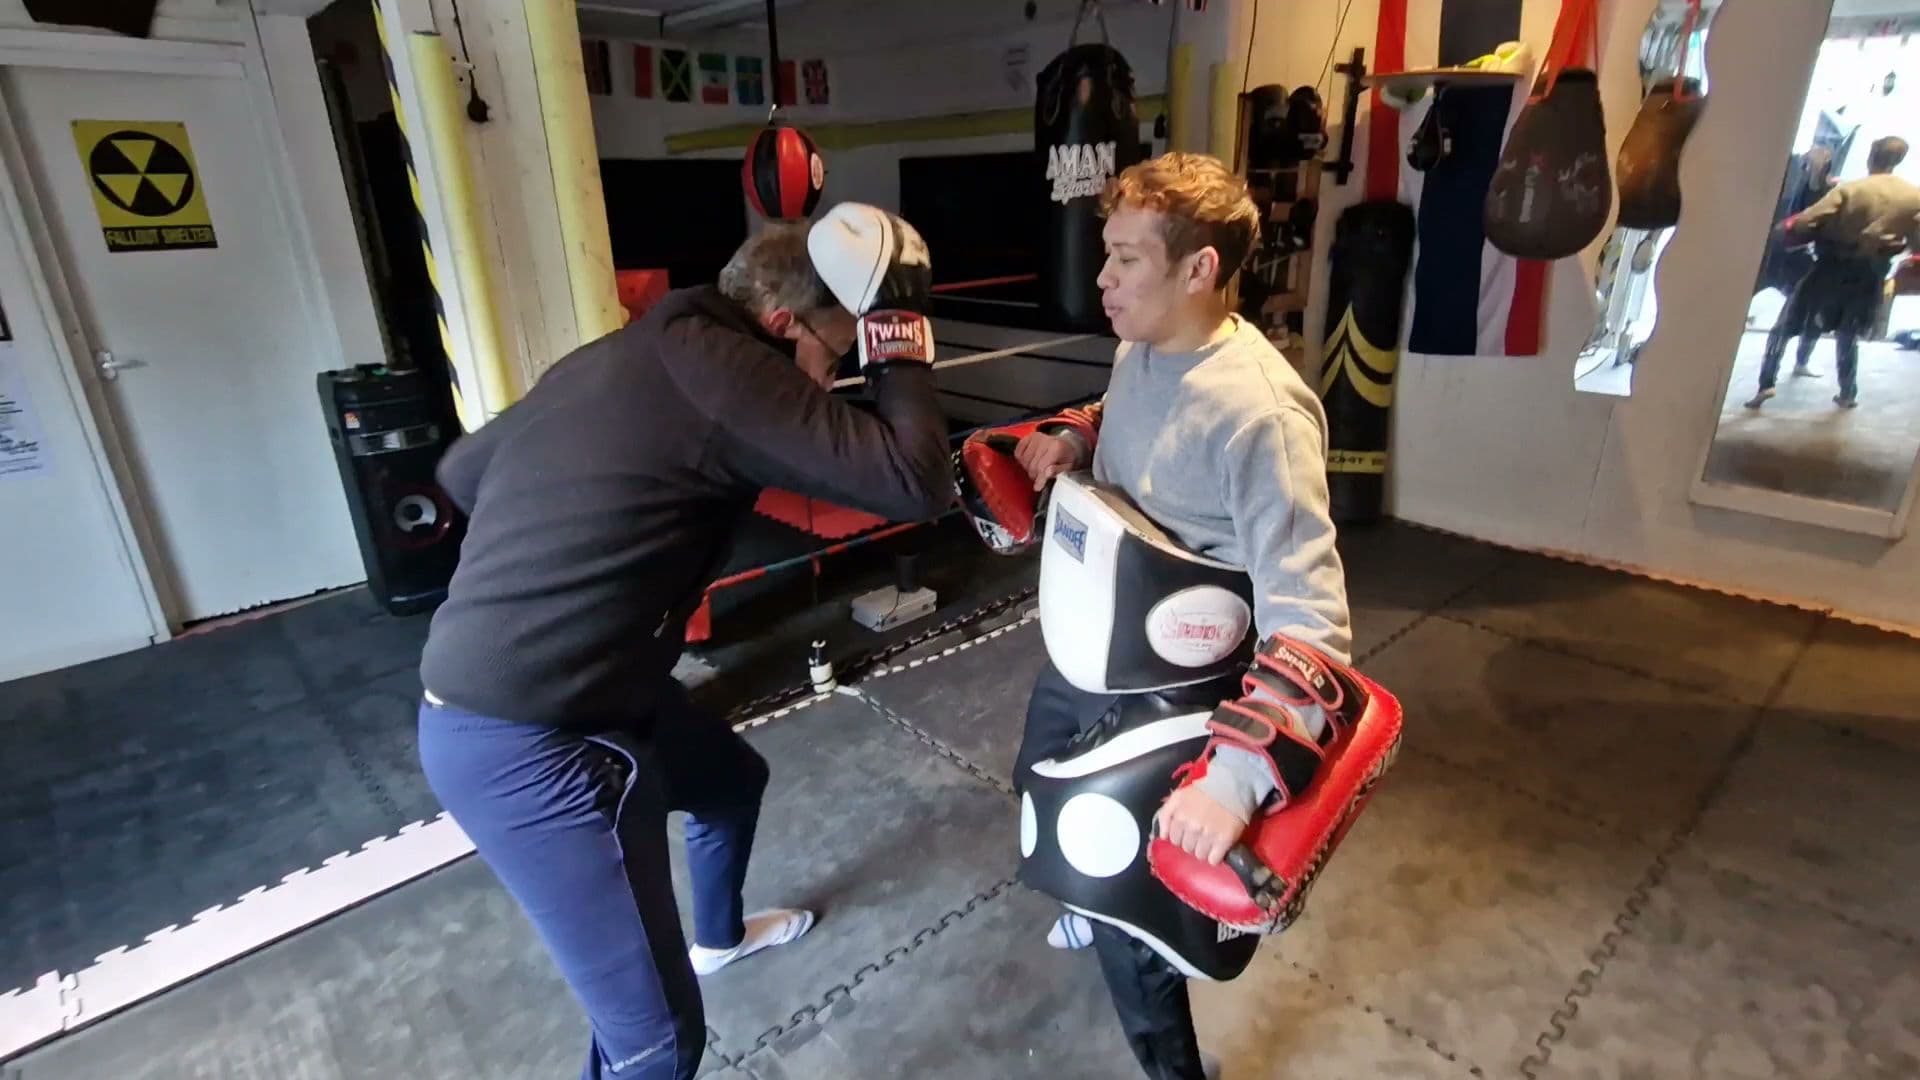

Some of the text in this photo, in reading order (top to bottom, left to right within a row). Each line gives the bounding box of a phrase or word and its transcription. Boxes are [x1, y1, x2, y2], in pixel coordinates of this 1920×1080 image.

[1046, 142, 1116, 180] AMAN
[105, 227, 211, 246] FALLOUT SHELTER
[867, 319, 923, 349] TWINS
